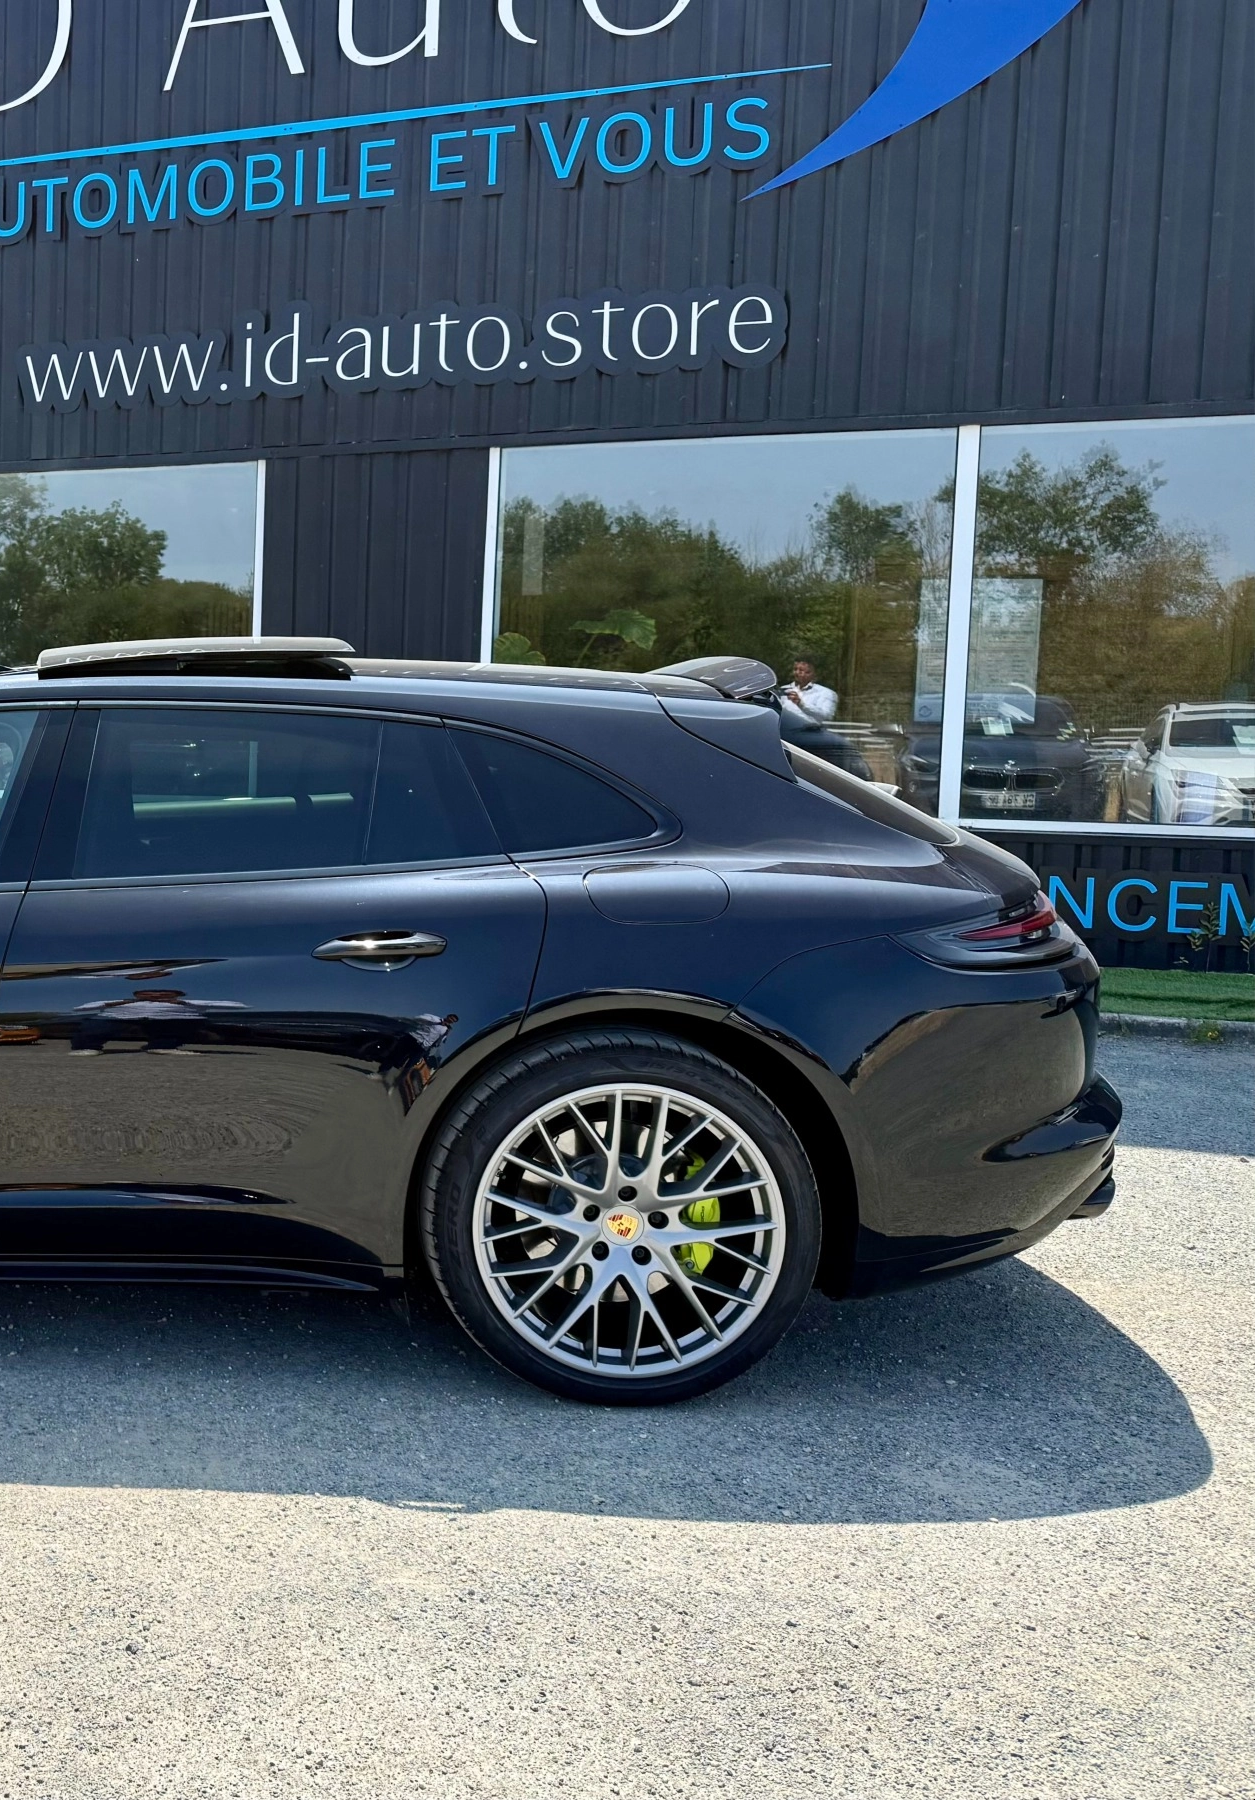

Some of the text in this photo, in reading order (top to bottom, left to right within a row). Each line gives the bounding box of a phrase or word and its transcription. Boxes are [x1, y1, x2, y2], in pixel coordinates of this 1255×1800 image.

[429, 125, 516, 191] ET
[540, 97, 770, 179] VOUS
[26, 293, 773, 402] www.id-auto.store
